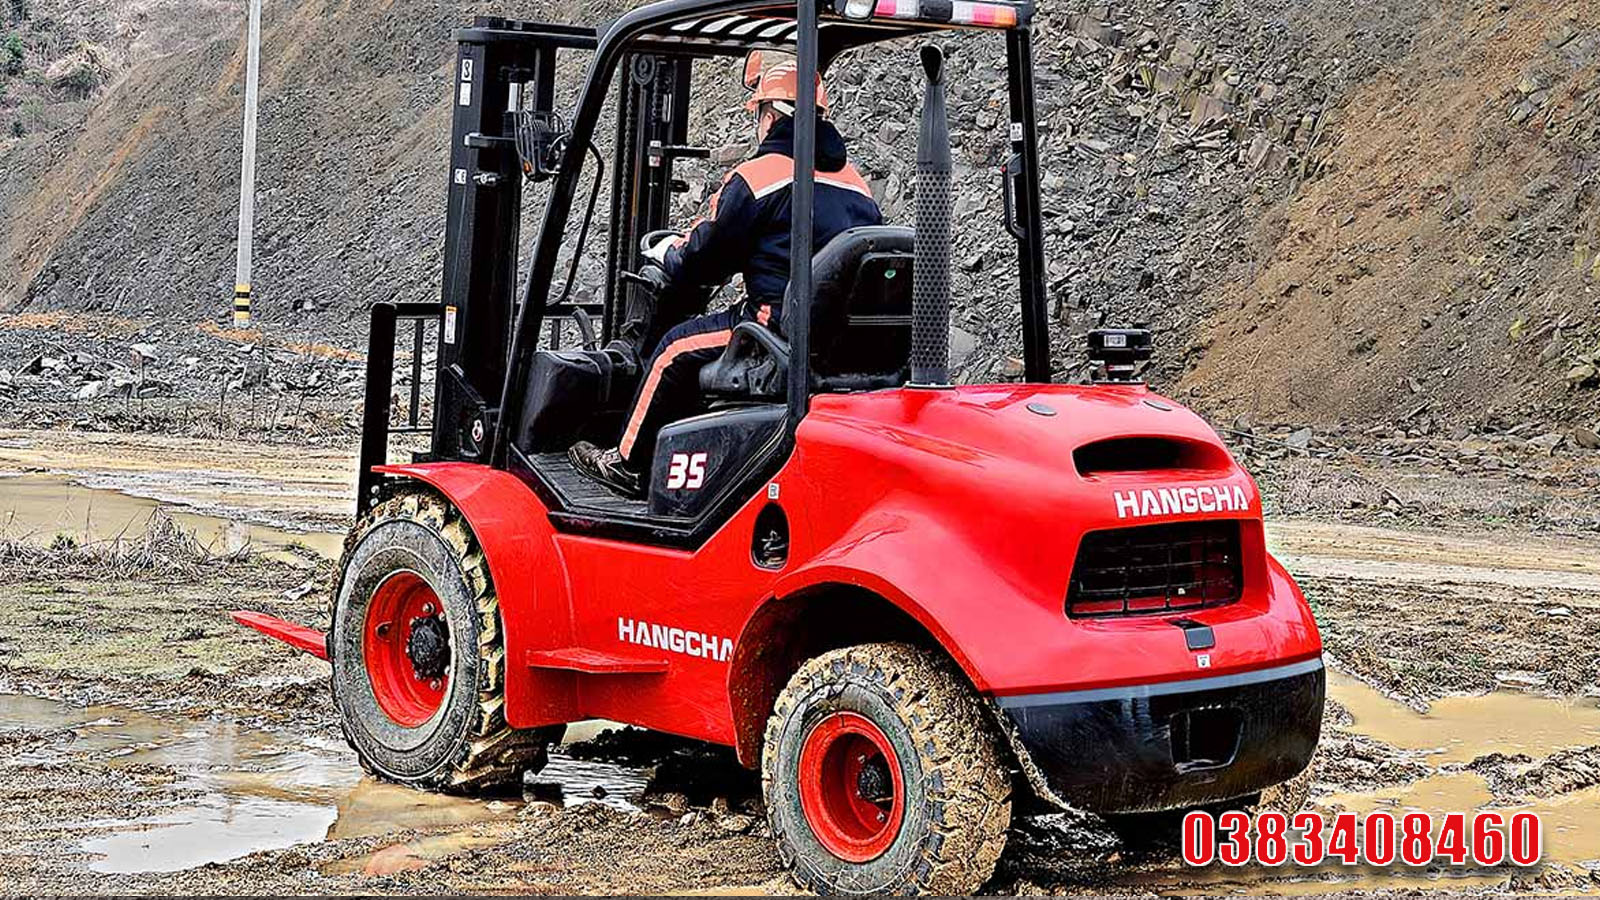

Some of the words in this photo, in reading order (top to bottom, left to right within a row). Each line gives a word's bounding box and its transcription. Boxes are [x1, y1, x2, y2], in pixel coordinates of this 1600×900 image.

[667, 453, 707, 489] 35
[1113, 485, 1249, 518] HANGCHA
[618, 616, 734, 662] HANGCHA
